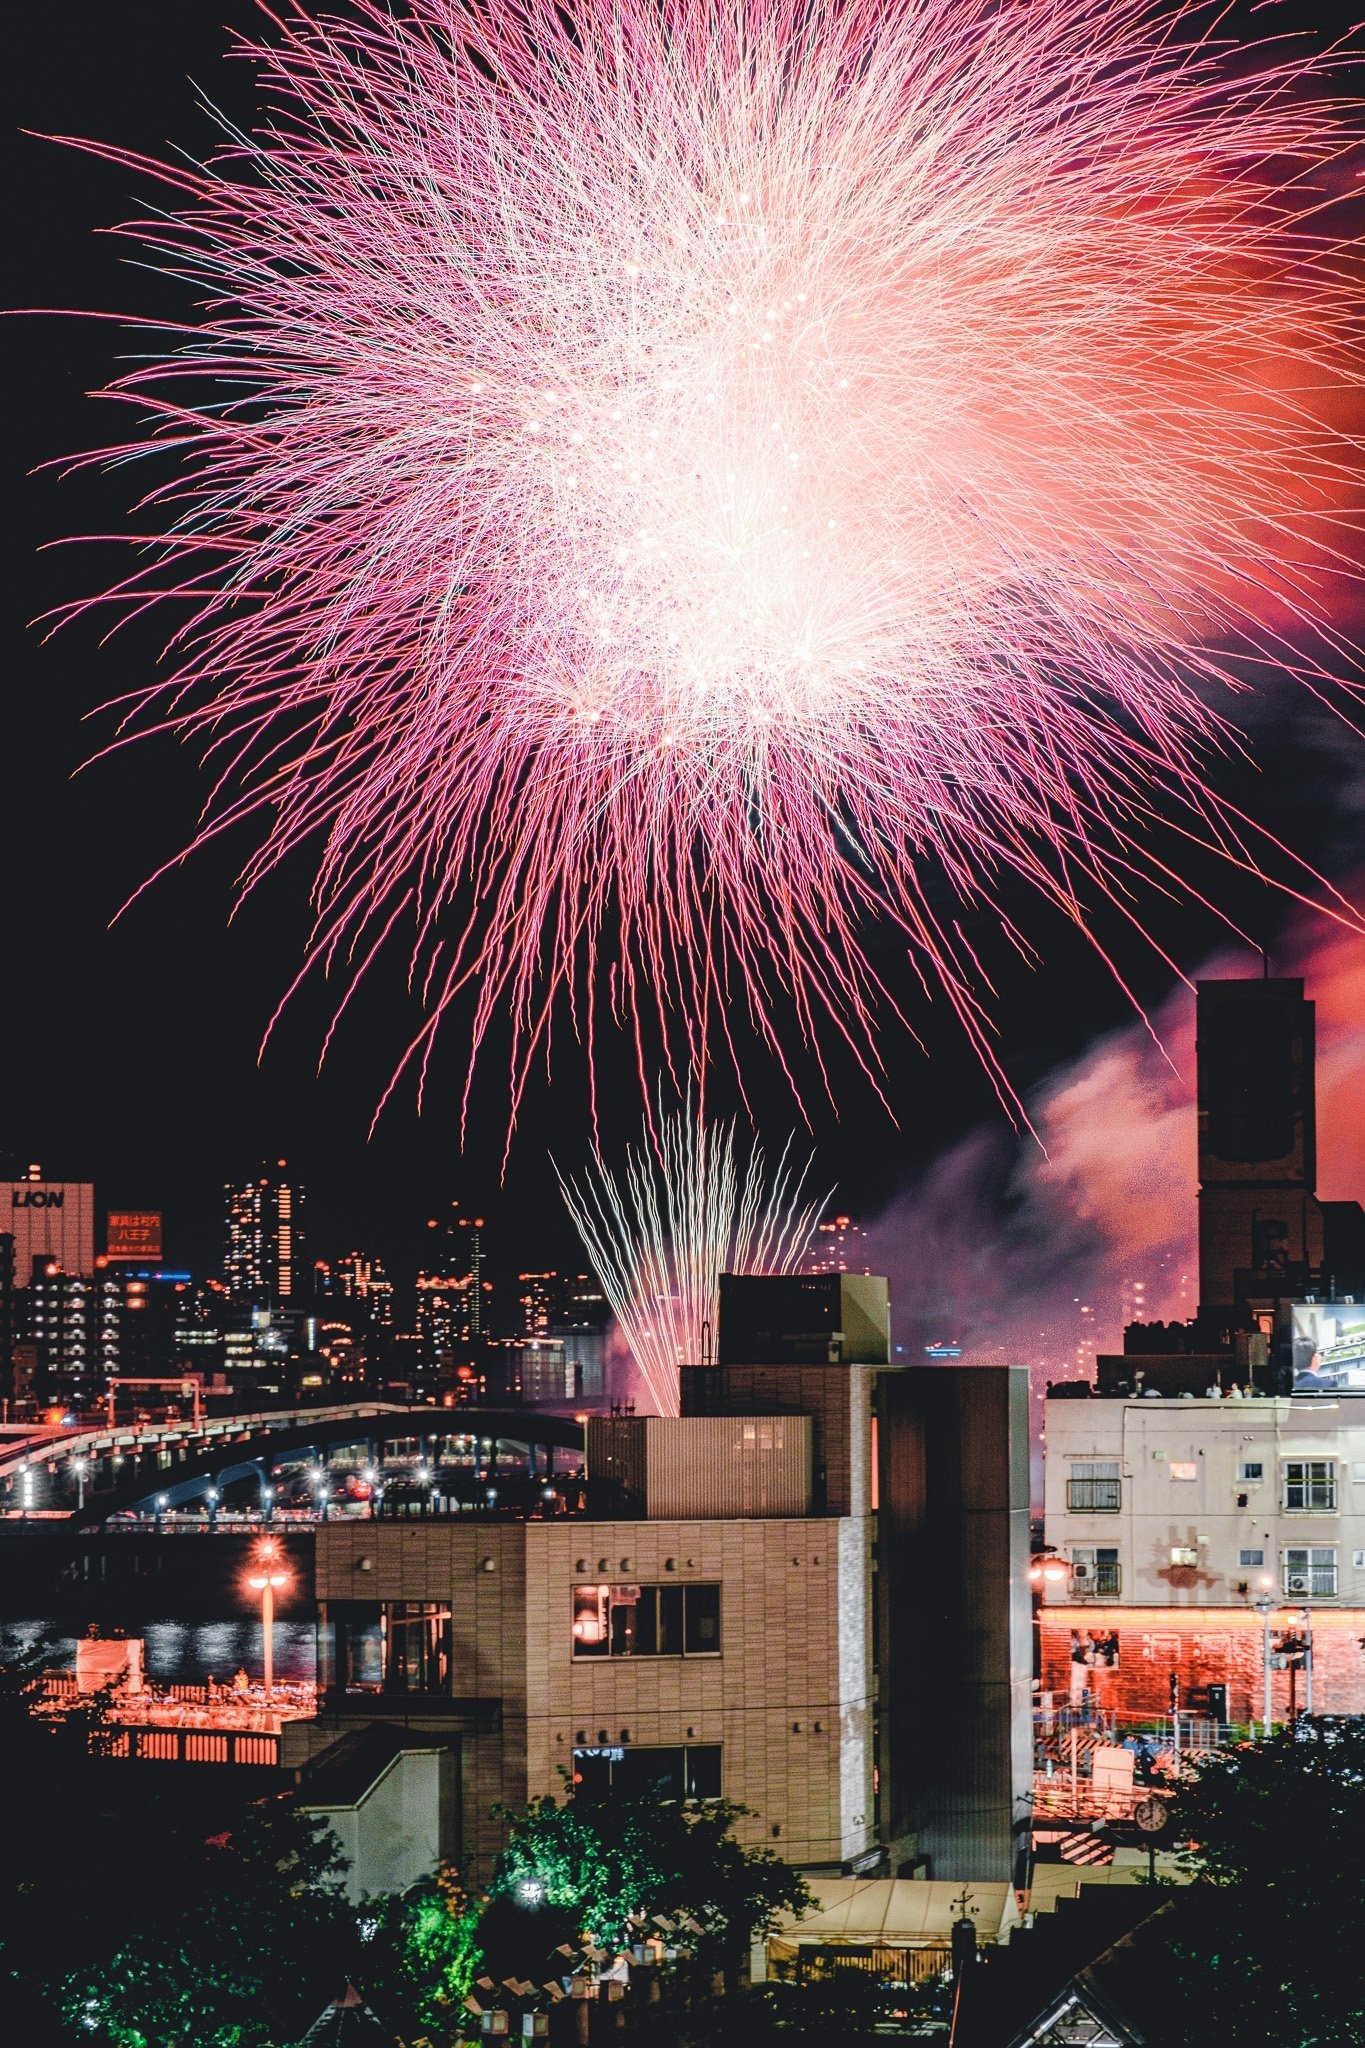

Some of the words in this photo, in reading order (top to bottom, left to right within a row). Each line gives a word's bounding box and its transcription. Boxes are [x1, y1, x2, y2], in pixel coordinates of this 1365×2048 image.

[12, 1191, 64, 1208] LION
[118, 1229, 151, 1241] 八王子
